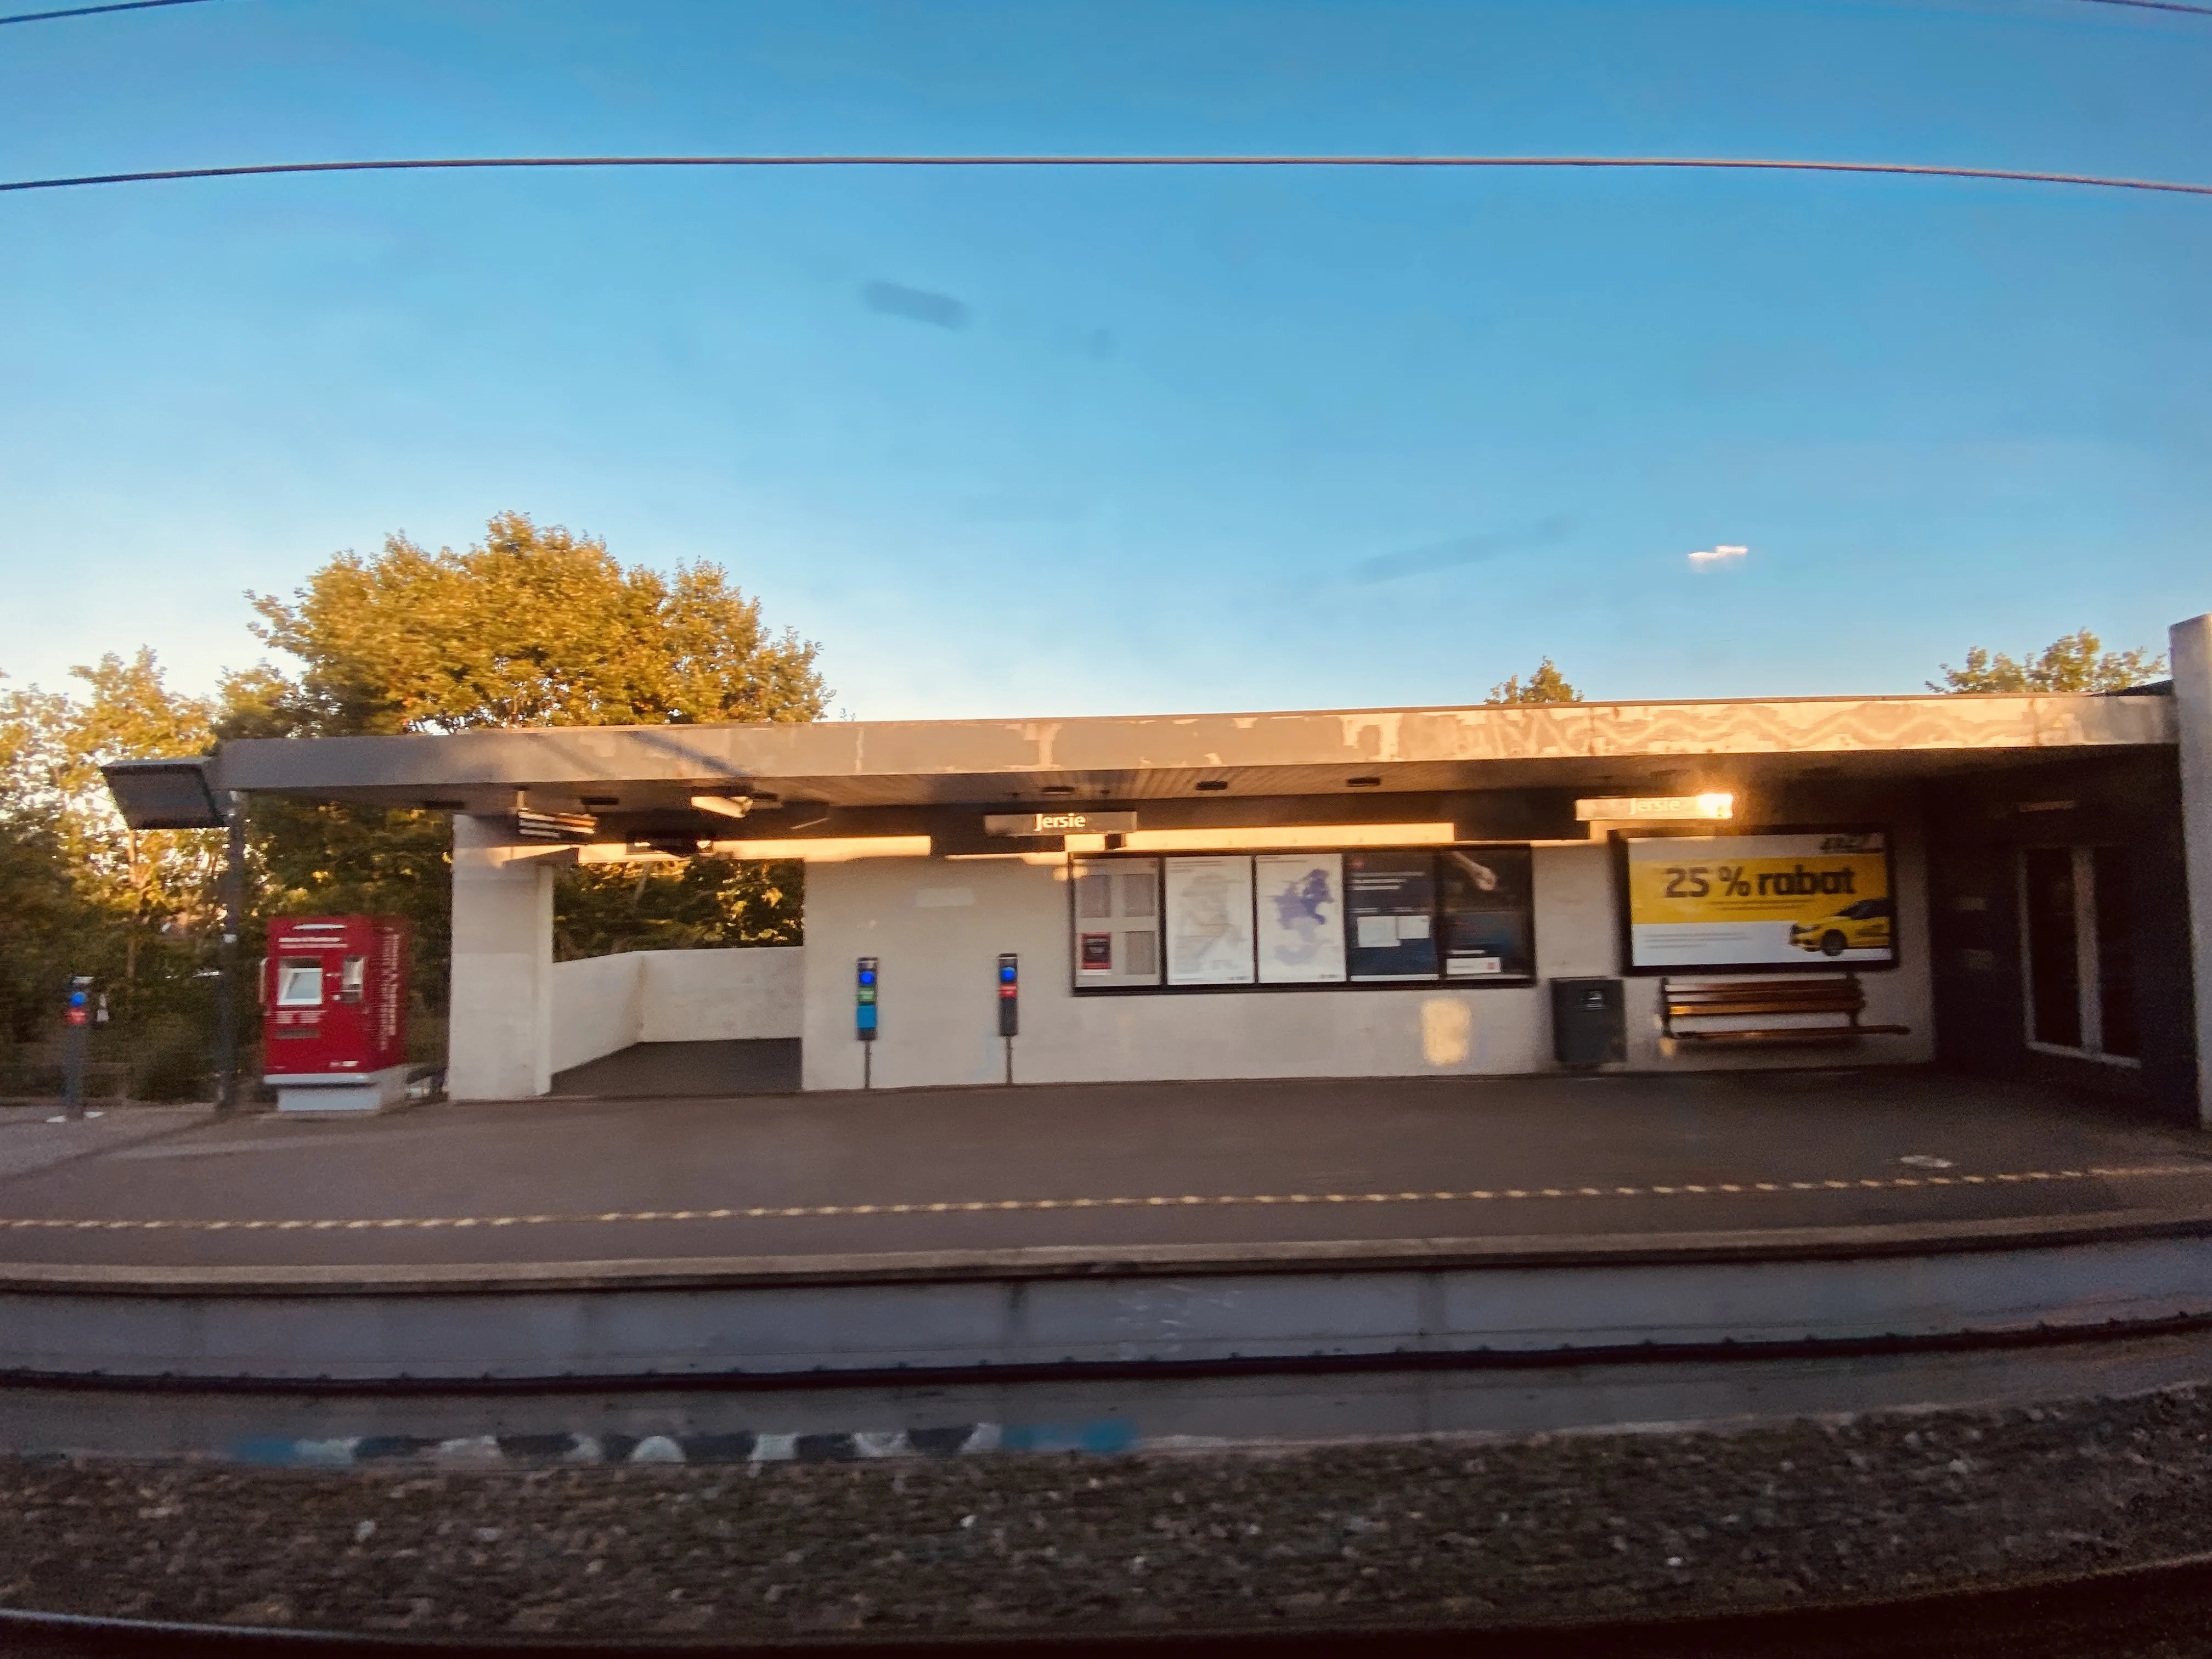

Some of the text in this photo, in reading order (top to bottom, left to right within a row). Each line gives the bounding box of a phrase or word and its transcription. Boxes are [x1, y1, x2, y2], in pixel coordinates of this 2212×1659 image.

[1629, 797, 1679, 815] Jersie
[1035, 812, 1086, 831] Jersie
[1666, 867, 1710, 898] 25
[1758, 865, 1855, 896] rabat
